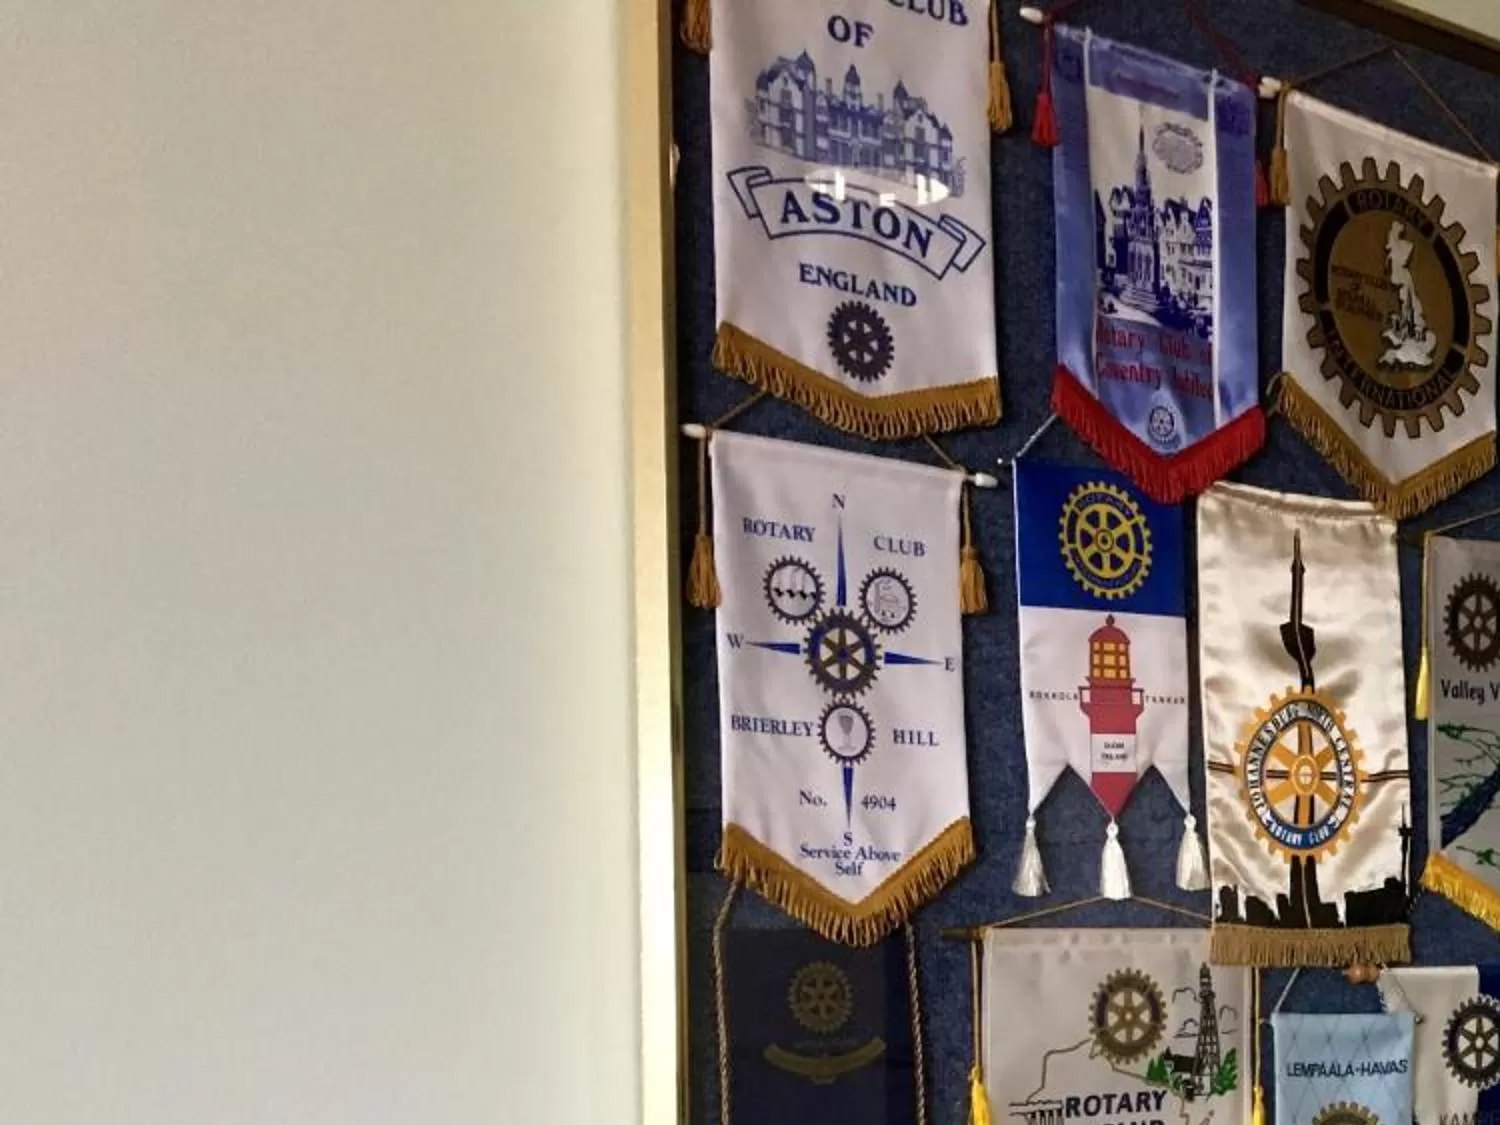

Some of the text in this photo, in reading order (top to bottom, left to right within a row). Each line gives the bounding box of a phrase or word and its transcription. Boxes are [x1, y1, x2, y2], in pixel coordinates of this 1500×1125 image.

[827, 15, 875, 48] OF
[780, 190, 935, 259] ASTON
[799, 262, 918, 308] ENGLAND
[832, 494, 846, 508] N
[743, 518, 927, 557] ROTARY CLUB
[727, 633, 746, 649] W
[945, 657, 956, 672] E
[1441, 680, 1485, 705] Valley
[731, 714, 940, 747] BRIERLEY HILL
[843, 833, 853, 847] S
[801, 846, 902, 863] Service Above
[836, 861, 863, 876] Self
[1066, 1090, 1168, 1118] ROTARY
